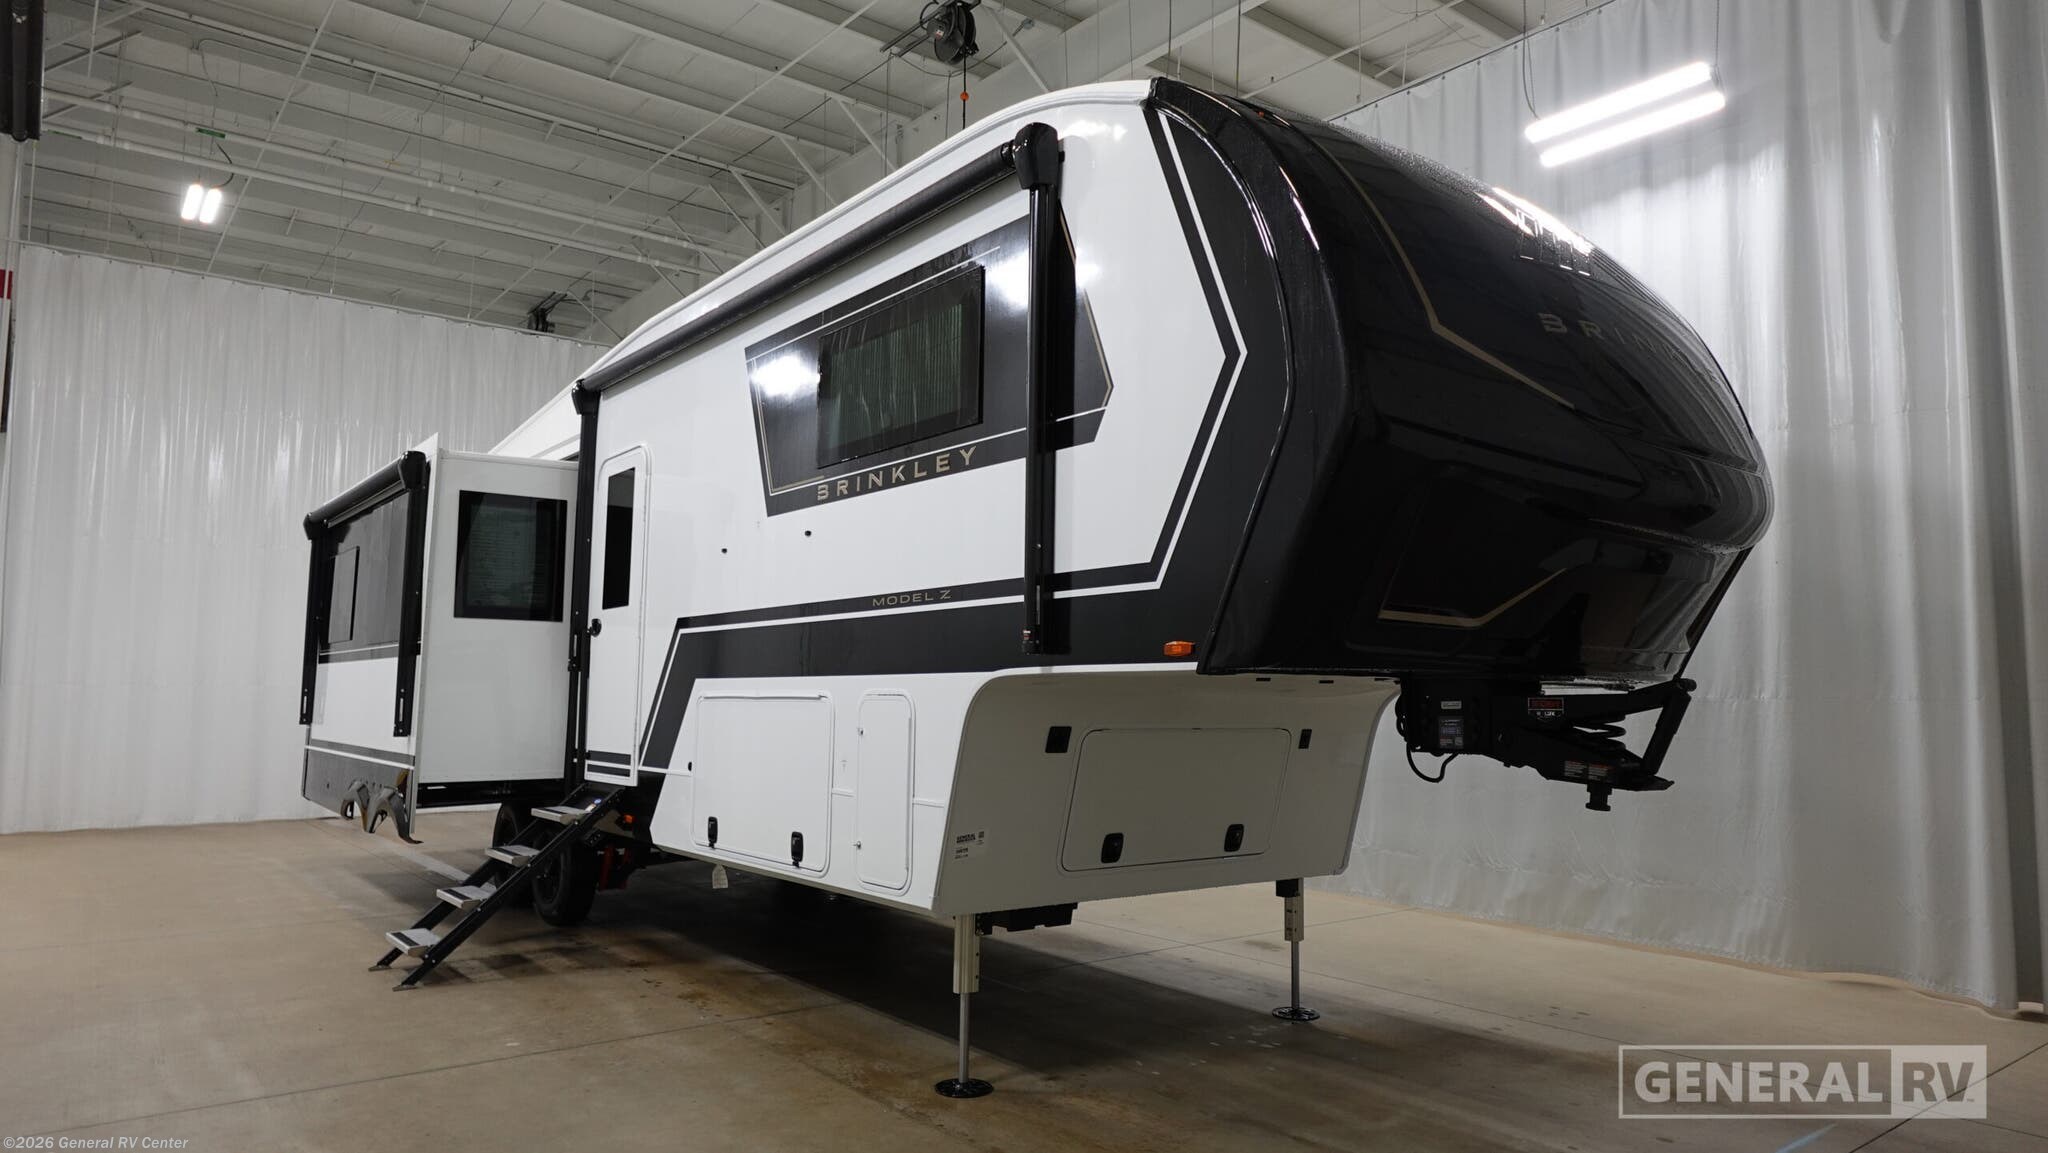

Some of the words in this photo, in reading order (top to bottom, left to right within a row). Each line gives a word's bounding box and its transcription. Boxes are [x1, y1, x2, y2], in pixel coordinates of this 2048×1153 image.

[817, 446, 976, 500] BRINKLEY
[872, 592, 934, 607] MODEL
[939, 589, 951, 600] Z
